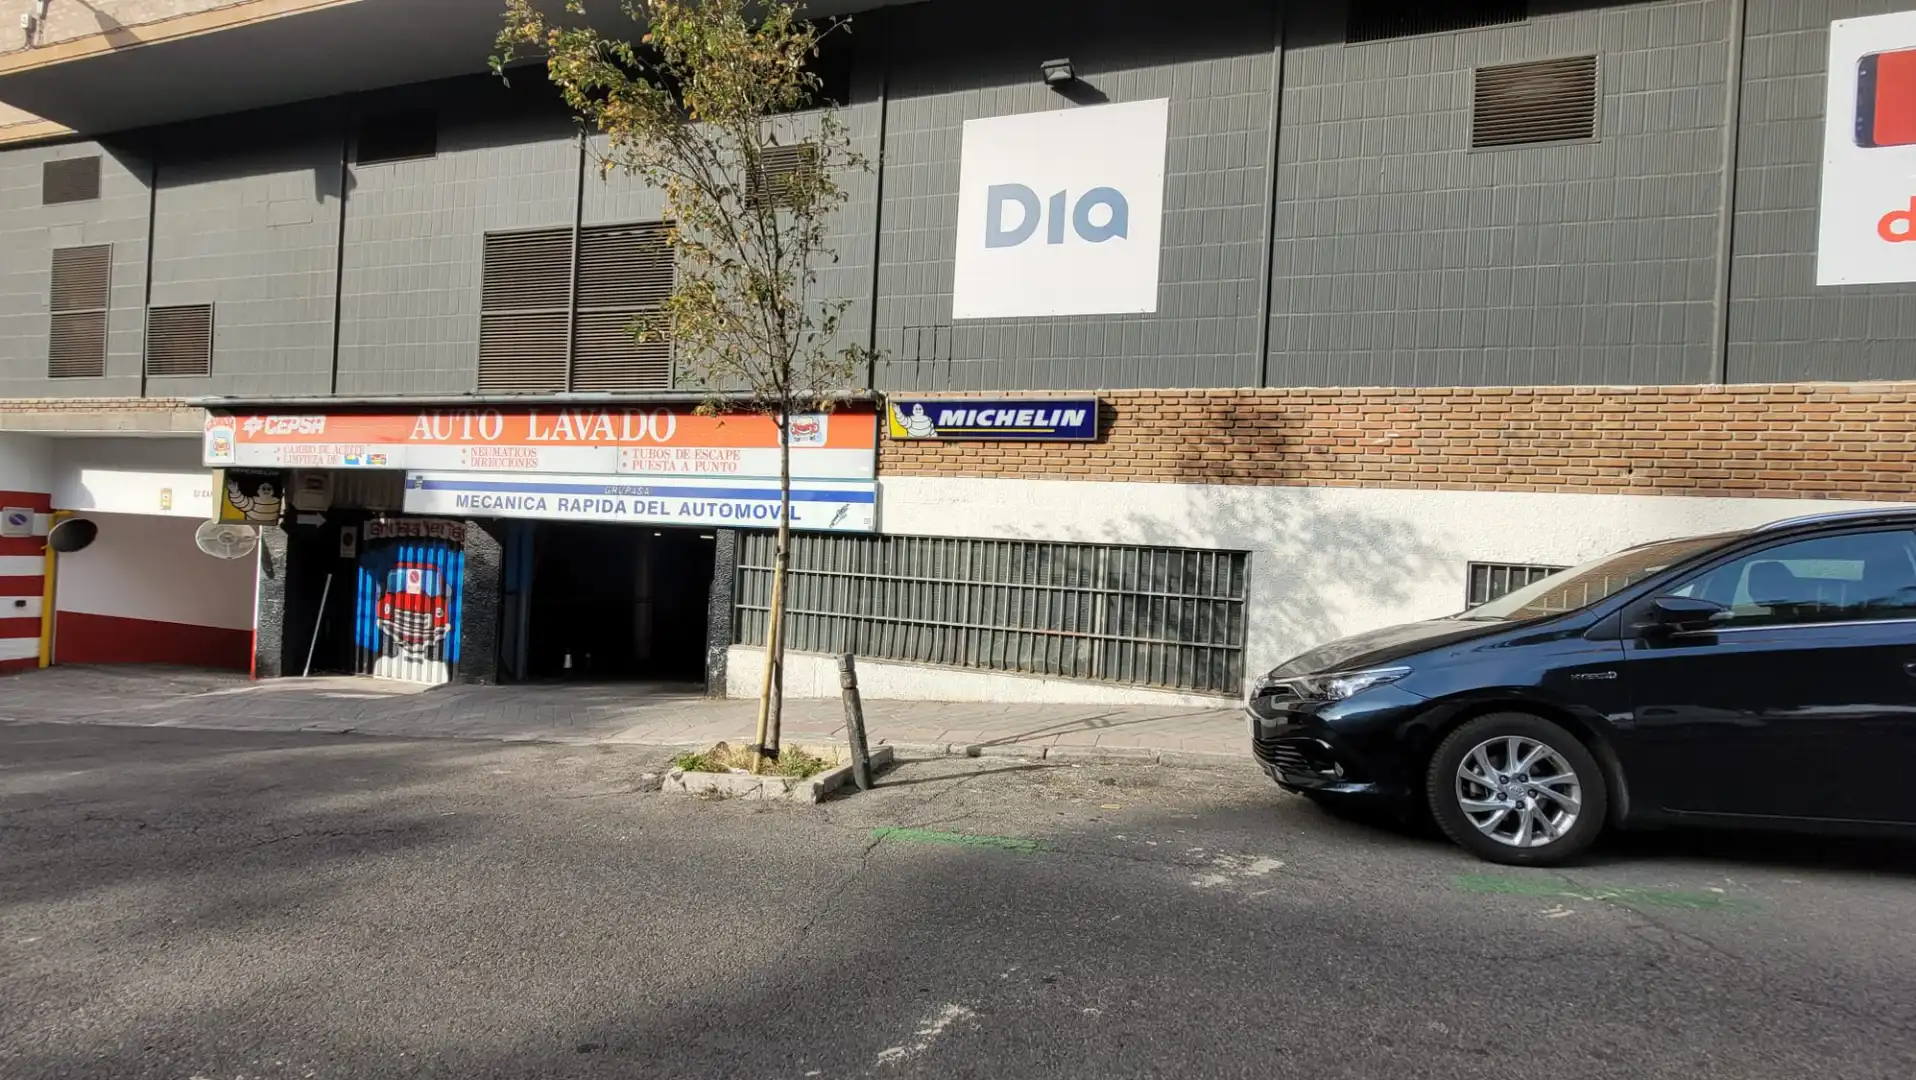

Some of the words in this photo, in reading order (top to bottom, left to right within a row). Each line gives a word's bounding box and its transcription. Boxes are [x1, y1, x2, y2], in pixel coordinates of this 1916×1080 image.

[938, 409, 1086, 427] MICHELIN
[264, 416, 326, 435] CEPSA
[409, 410, 503, 441] AUTO
[526, 409, 676, 442] LAVADO
[319, 445, 329, 454] DE
[471, 447, 537, 458] NEUMATICOS
[632, 448, 671, 459] TUBOS
[676, 449, 691, 460] DE
[695, 449, 741, 461] ESCAPE
[284, 455, 323, 464] LIMPIEZA
[471, 458, 538, 468] DIRECCIONES
[632, 460, 676, 471] PUESTA
[680, 461, 690, 472] A
[695, 461, 737, 473] PUNTO
[456, 494, 546, 511] MECANICA
[558, 498, 626, 514] RAPIDA
[633, 500, 670, 515] DEL
[679, 502, 802, 521] AUTOMOVL
